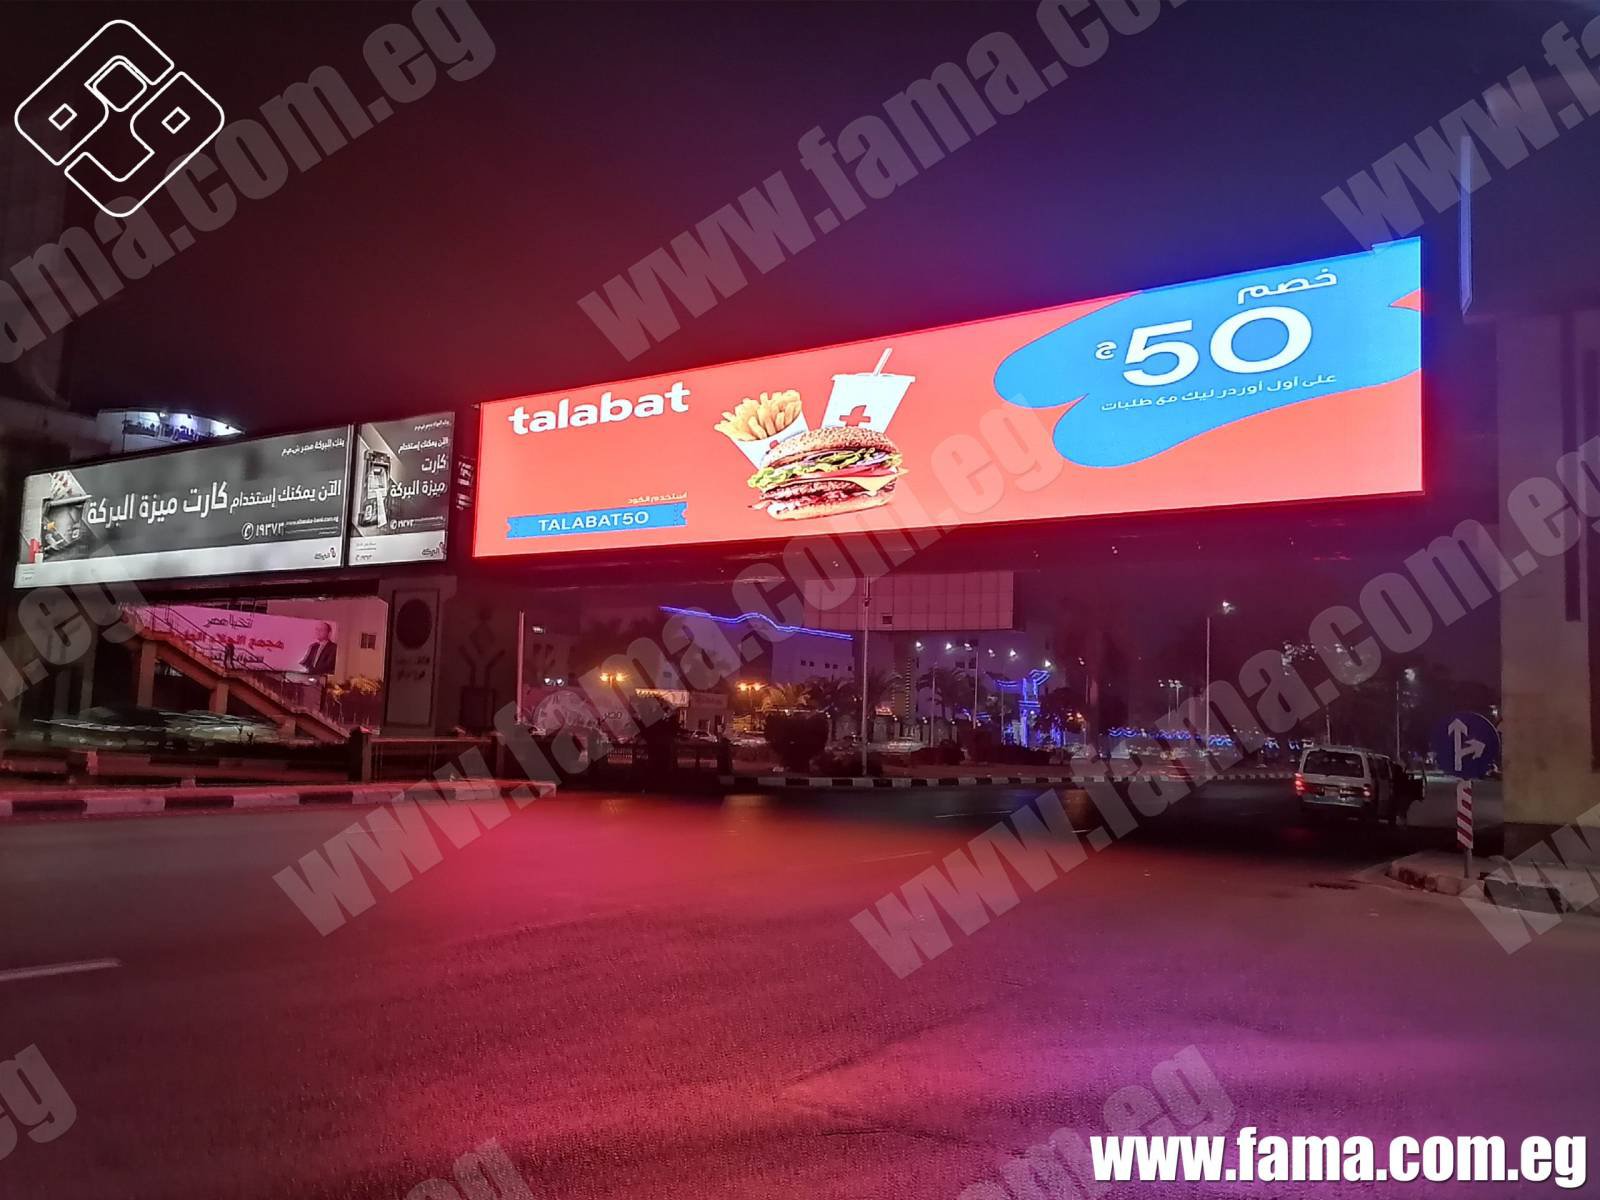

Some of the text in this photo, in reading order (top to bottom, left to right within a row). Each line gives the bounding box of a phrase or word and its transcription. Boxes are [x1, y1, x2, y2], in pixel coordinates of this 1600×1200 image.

[1237, 268, 1338, 304] خصم
[1302, 374, 1337, 388] على
[508, 381, 691, 436] talabat
[1101, 398, 1153, 411] طلبات
[1155, 395, 1178, 407] مع
[421, 453, 448, 473] كارت
[390, 480, 447, 499] ميزة البركة
[87, 479, 342, 528] الآن يمكنك إستخدام كارت ميزة البركة
[538, 511, 650, 532] TALABAT50
